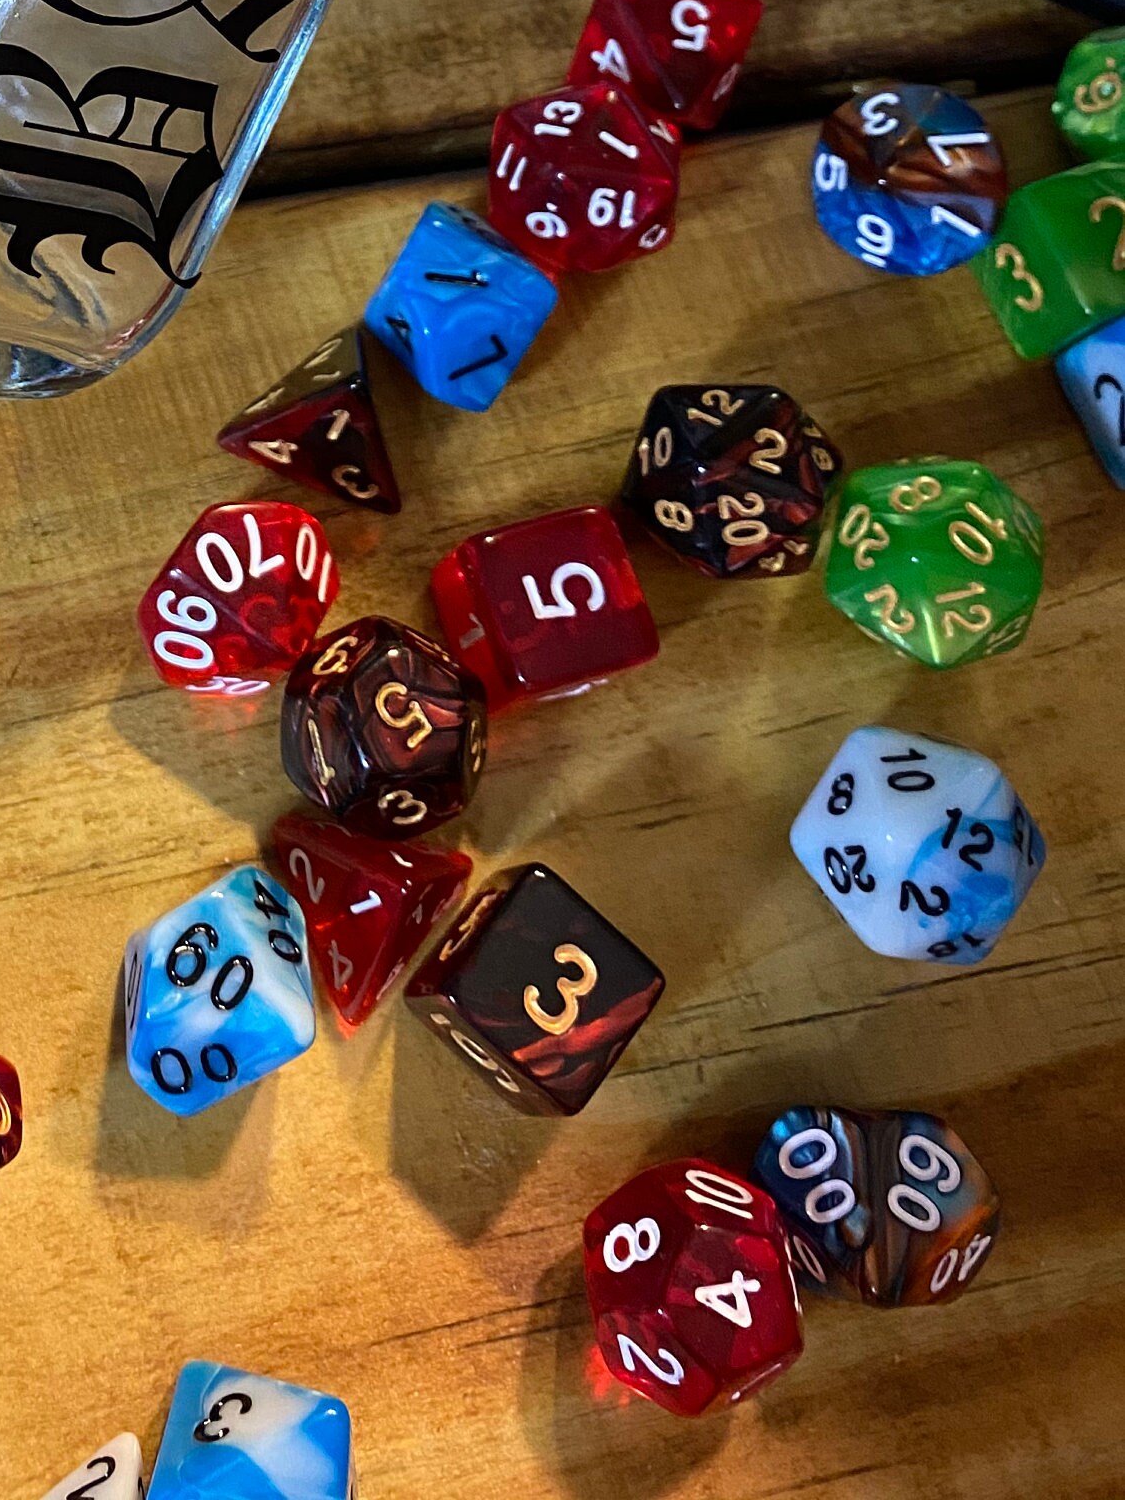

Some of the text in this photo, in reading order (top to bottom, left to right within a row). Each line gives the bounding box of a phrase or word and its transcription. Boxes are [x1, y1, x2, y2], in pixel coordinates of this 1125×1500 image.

[671, 0, 711, 52] 5
[591, 38, 632, 84] 4
[534, 100, 581, 137] 13
[861, 93, 899, 136] 3
[496, 144, 528, 191] 11
[598, 130, 640, 160] 1
[926, 132, 991, 167] 7
[815, 153, 848, 192] 5
[588, 187, 637, 229] 19
[931, 206, 981, 238] 1
[994, 243, 1044, 312] 3
[447, 333, 509, 381] 7
[326, 408, 351, 440] 1
[687, 389, 744, 427] 12
[249, 439, 299, 464] 4
[638, 427, 672, 477] 10
[748, 427, 788, 475] 2
[331, 464, 380, 499] 3
[889, 476, 942, 512] 8
[654, 500, 695, 532] 8
[718, 492, 770, 547] 20
[838, 504, 890, 570] 20
[949, 501, 1008, 566] 10
[196, 513, 286, 593] 70
[522, 561, 606, 620] 5
[863, 584, 916, 634] 2
[935, 581, 993, 639] 12
[376, 681, 433, 750] 5
[827, 772, 855, 816] 8
[880, 747, 936, 793] 10
[377, 790, 428, 826] 3
[941, 806, 995, 873] 12
[289, 847, 325, 905] 2
[823, 845, 876, 894] 20
[254, 879, 302, 963] 40
[349, 889, 383, 915] 1
[899, 879, 951, 917] 2
[166, 922, 255, 1012] 60
[328, 939, 354, 990] 4
[522, 942, 598, 1036] 3
[150, 1042, 238, 1095] 00
[685, 1169, 754, 1220] 10
[778, 1127, 857, 1224] 00
[602, 1216, 661, 1273] 8
[694, 1269, 762, 1329] 4
[616, 1333, 685, 1385] 2
[193, 1392, 253, 1443] 3
[65, 1455, 116, 1500] 2
